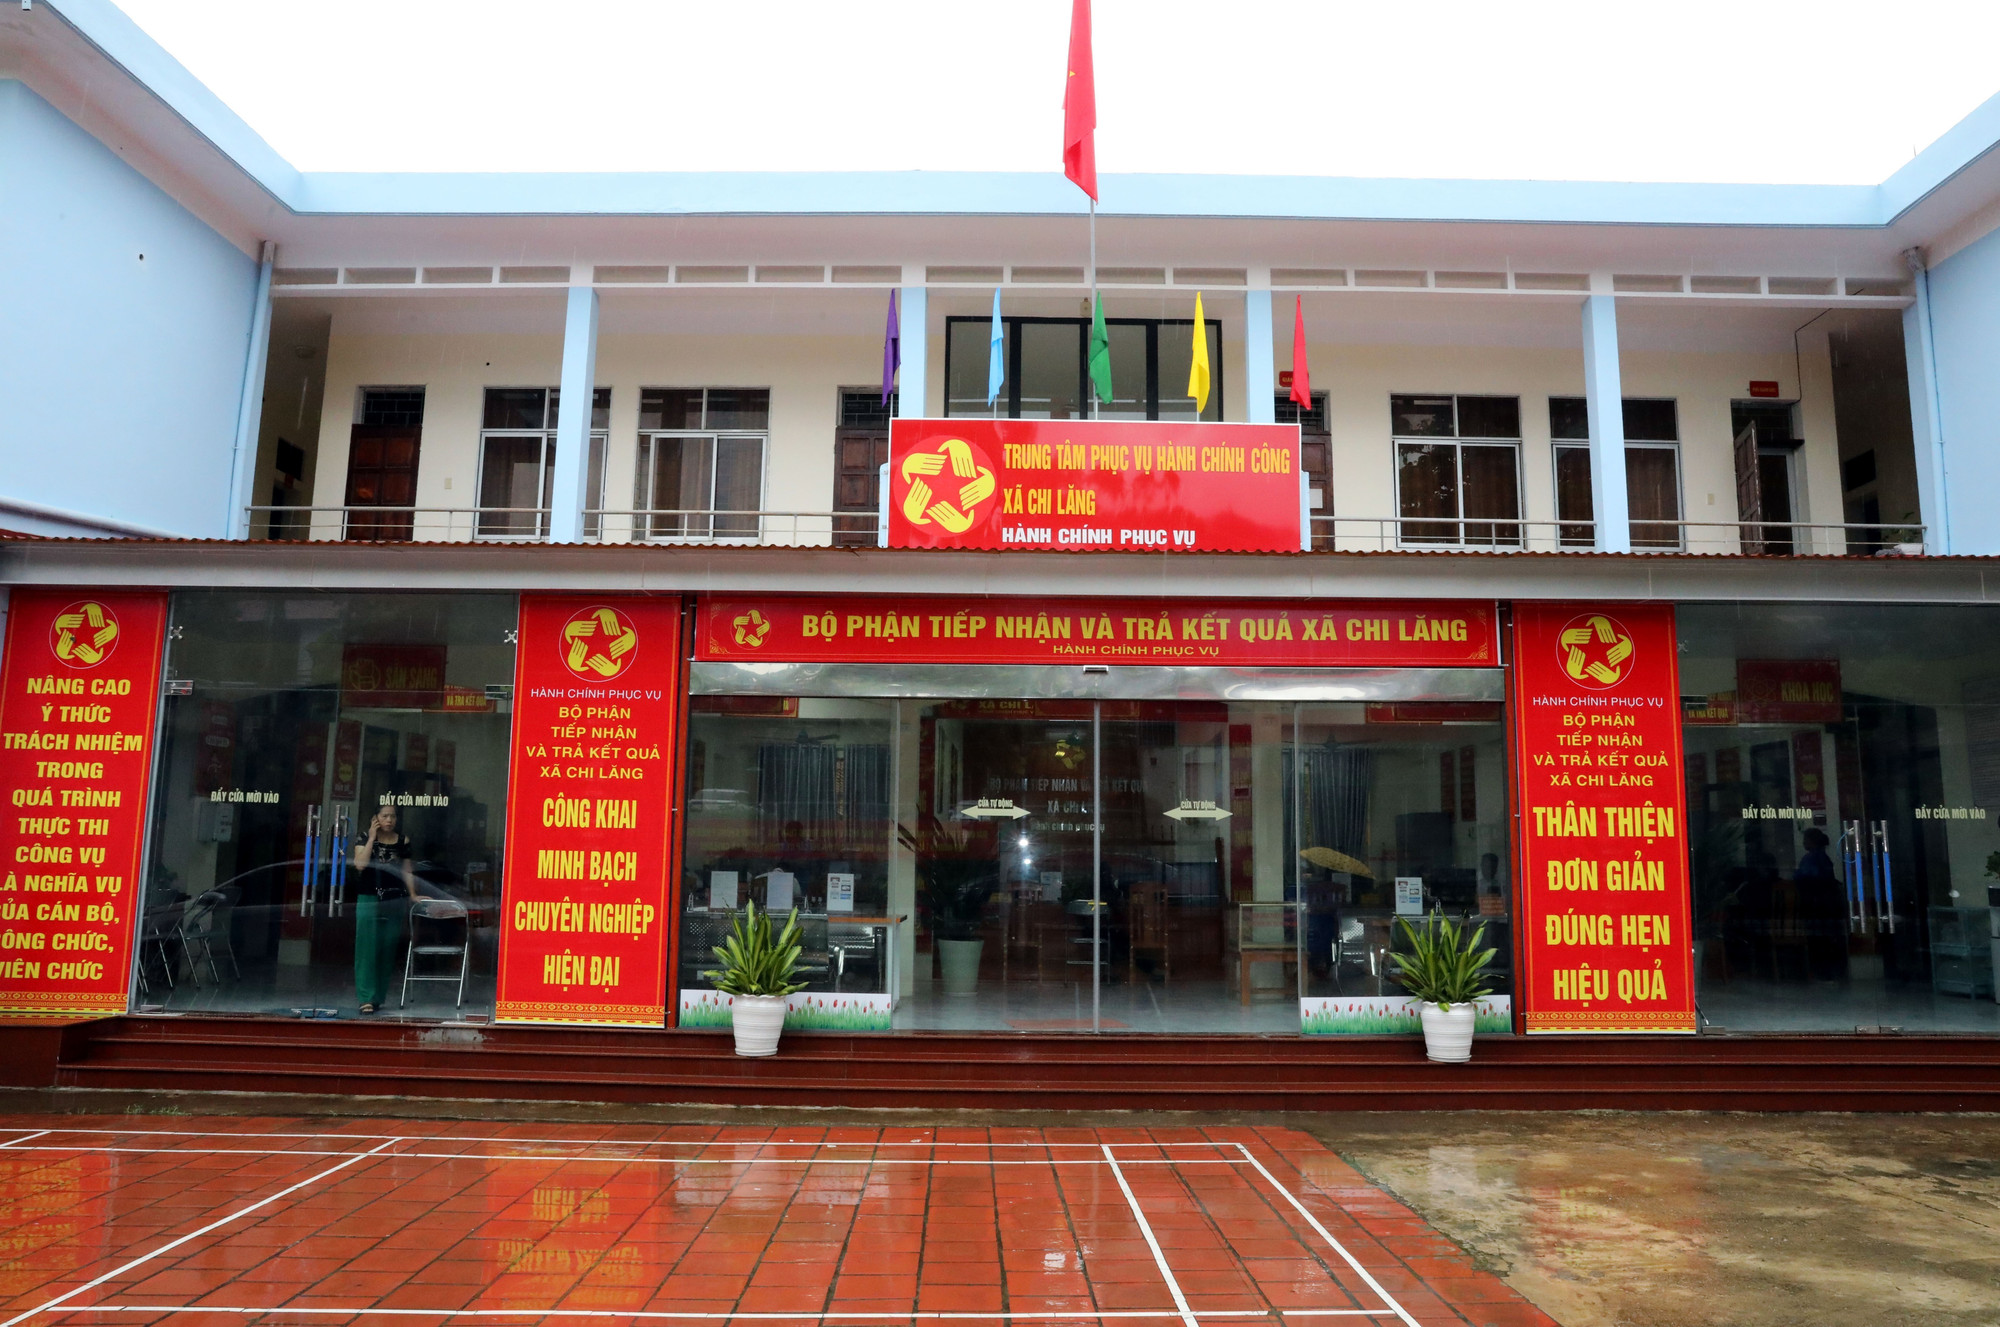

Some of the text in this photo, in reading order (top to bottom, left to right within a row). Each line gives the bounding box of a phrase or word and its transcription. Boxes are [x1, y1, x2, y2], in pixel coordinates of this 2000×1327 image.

[1004, 439, 1290, 474] TRUNG TÂM PHỤC VỤ HÀNH CHÍNH CÔNG
[1003, 484, 1095, 515] XÃ CHI LĂNG
[1003, 523, 1195, 548] HÀNH CHÍNH PHỤC VỤ
[803, 611, 1467, 643] BỘ PHẬN TIẾP NHẬN VÀ TRẢ KẾT QUẢ XÃ CHI LĂNG
[1101, 646, 1147, 654] CHÍNH
[1153, 647, 1193, 656] PHỤC
[1199, 647, 1218, 657] VỤ
[27, 676, 130, 695] NÂNG CAO
[531, 689, 661, 700] HÀNH CHÍNH PHỤC VỤ
[1781, 680, 1810, 702] KHOA
[560, 704, 630, 720] BỘ PHẬN
[1533, 697, 1663, 708] HÀNH CHÍNH PHỤC VỤ
[42, 704, 111, 722] Ý THỨC
[1564, 712, 1634, 728] BỘ PHẬN
[551, 723, 636, 740] TIẾP NHẬN
[1557, 731, 1642, 748] TIẾP NHẬN
[4, 731, 142, 754] TRÁCH NHIỆM
[527, 743, 660, 759] VÀ TRẢ KẾT QUẢ
[1534, 751, 1668, 766] VÀ TRẢ KẾT QUẢ
[37, 762, 103, 778] TRONG
[541, 764, 643, 779] XÃ CHI LĂNG
[1551, 772, 1653, 786] XÃ CHI LĂNG
[13, 787, 121, 807] QUÁ TRÌNH
[211, 787, 279, 803] ĐẨY CỬA MỜI VÀO
[380, 791, 448, 806] ĐẨY CỬA MỜI VÀO
[543, 791, 636, 828] CÔNG KHAI
[1743, 804, 1812, 819] ĐẨY CỬA MỜI VÀO
[1916, 804, 1985, 819] ĐẨY CỬA MỜI VÀO
[19, 817, 109, 838] THỰC THI
[1533, 801, 1674, 844] THÂN THIỆN
[16, 843, 105, 867] CÔNG VỤ
[538, 850, 636, 887] MINH BẠCH
[1547, 851, 1664, 891] ĐƠN GIẢN
[0, 871, 122, 896] À NGHĨA VỤ
[0, 898, 119, 925] ỦA CÁN BỘ,
[515, 896, 654, 941] CHUYÊN NGHIỆP
[1546, 908, 1670, 950] ĐÚNG HẸN
[0, 929, 113, 953] ÔNG CHỨC,
[47, 960, 103, 980] CHỨC
[544, 950, 619, 992] HIỆN ĐẠI
[1554, 959, 1667, 1007] HIỆU QUẢ
